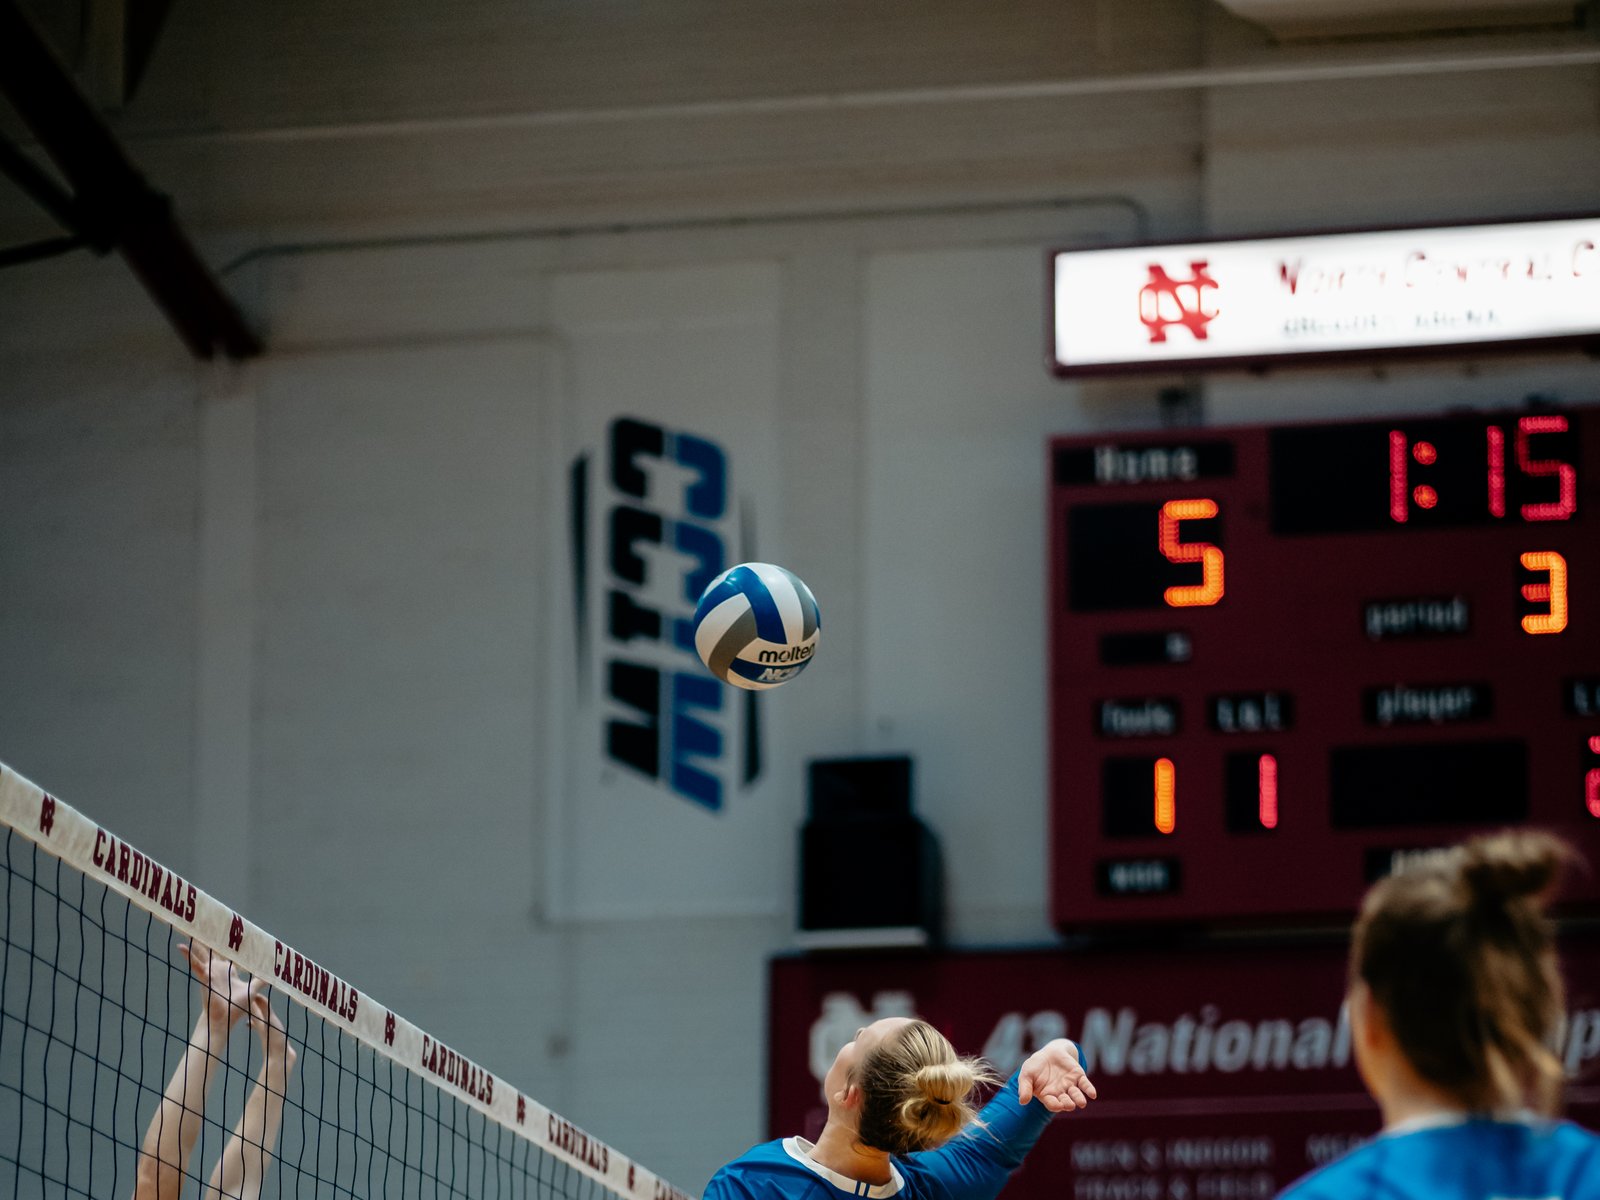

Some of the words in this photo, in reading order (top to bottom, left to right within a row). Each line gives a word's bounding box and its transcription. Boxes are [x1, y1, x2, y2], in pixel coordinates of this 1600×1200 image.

[1390, 416, 1577, 522] 1:15
[1159, 499, 1224, 606] 5
[1521, 552, 1568, 634] 3
[1154, 757, 1175, 834] 1
[1259, 754, 1278, 829] 1
[92, 827, 197, 924] CARDINALS
[273, 940, 359, 1023] CARDINALS
[422, 1033, 494, 1106] CARDINALS
[1080, 1006, 1350, 1076] National
